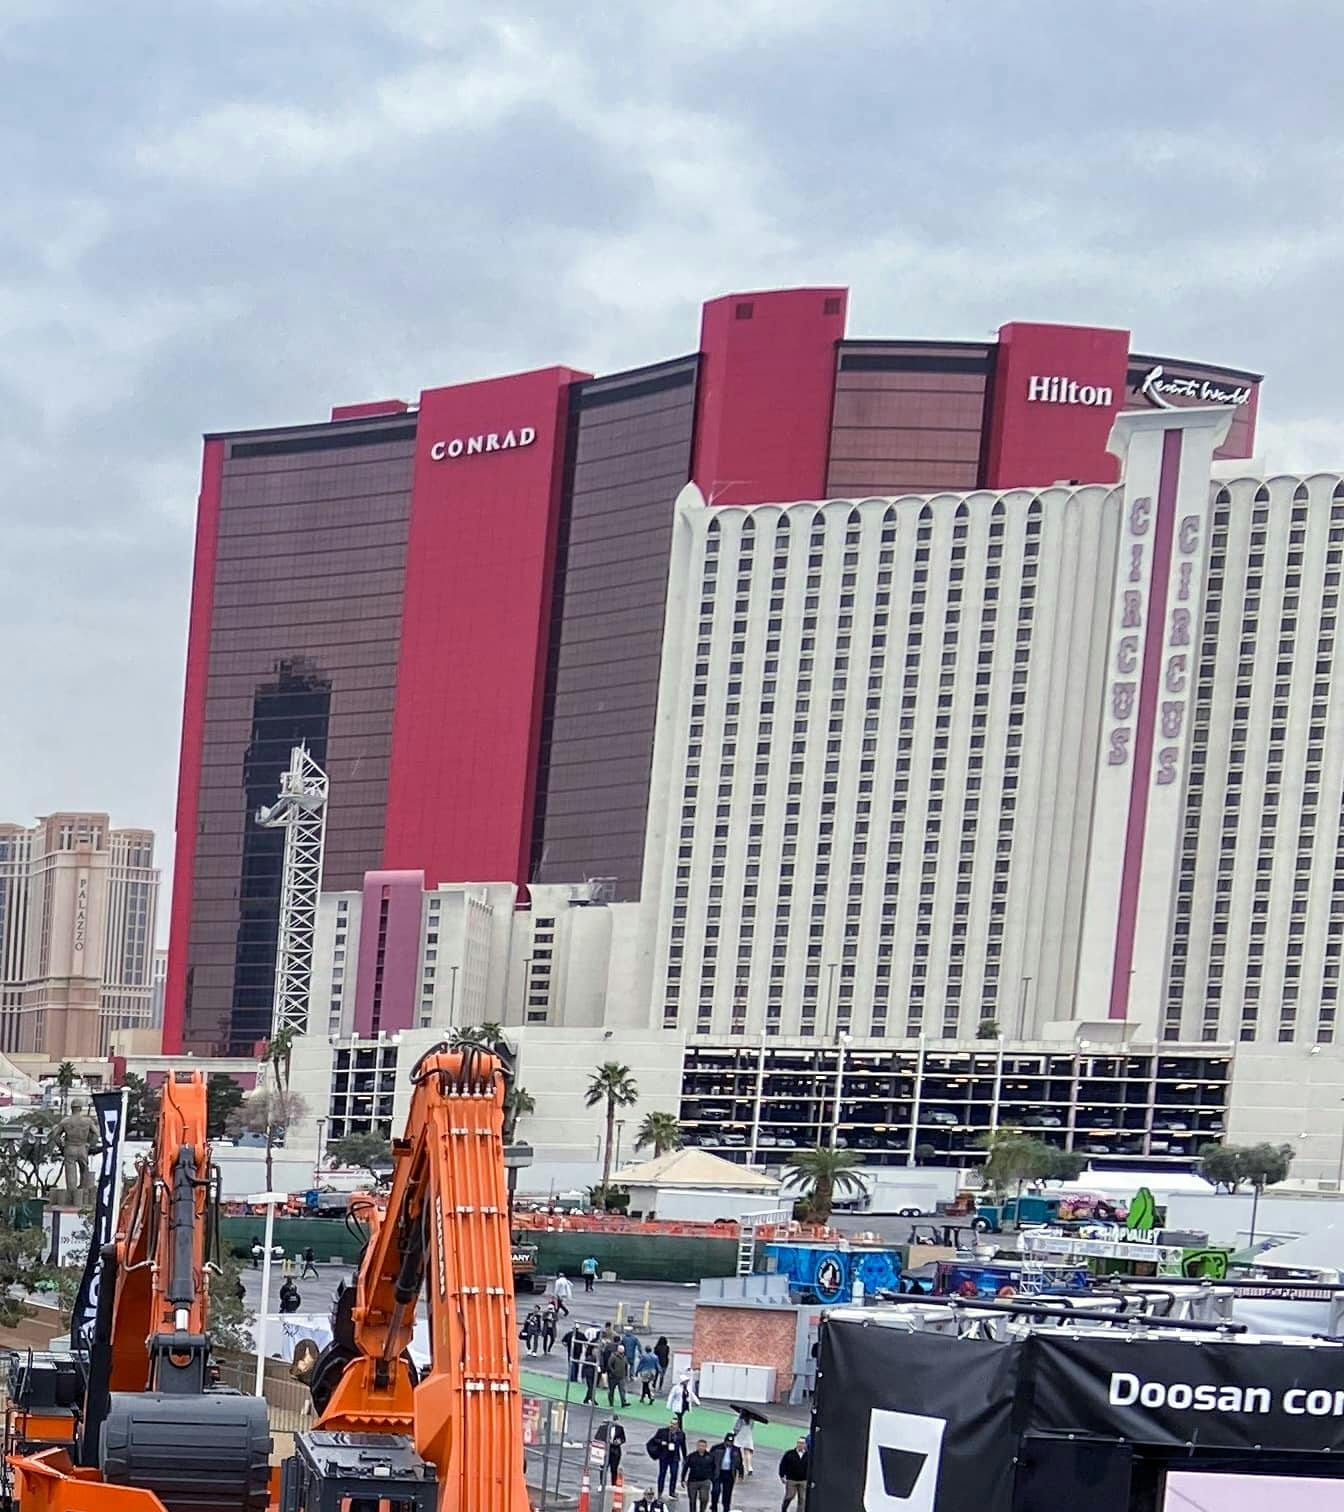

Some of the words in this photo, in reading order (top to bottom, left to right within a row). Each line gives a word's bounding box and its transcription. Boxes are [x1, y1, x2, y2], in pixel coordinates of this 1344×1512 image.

[1028, 376, 1112, 406] Hilton
[431, 426, 536, 461] CONRAD
[1108, 497, 1152, 766] CIRCUS
[1156, 515, 1200, 786] CIRCUS
[74, 878, 86, 952] PALAZZO
[1109, 1373, 1270, 1413] Doosan
